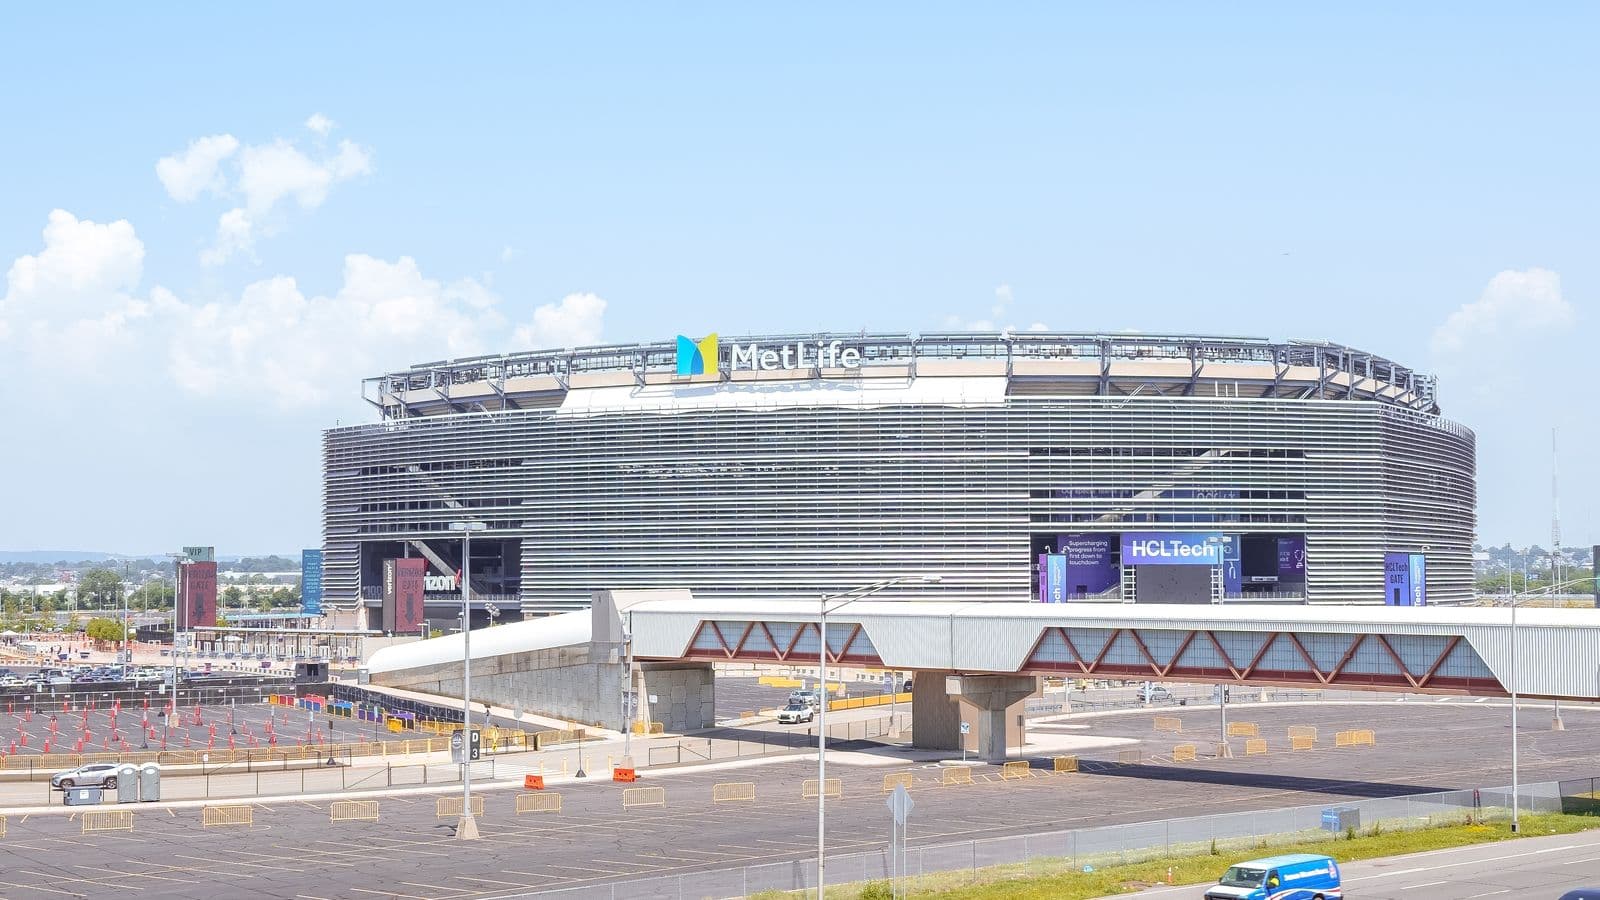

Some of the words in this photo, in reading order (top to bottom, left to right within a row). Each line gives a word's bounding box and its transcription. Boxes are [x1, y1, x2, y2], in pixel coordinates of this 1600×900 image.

[731, 340, 860, 371] MetLife
[190, 548, 202, 556] VIP
[1132, 540, 1215, 557] HCLTech
[472, 732, 479, 742] D
[472, 748, 478, 758] 3
